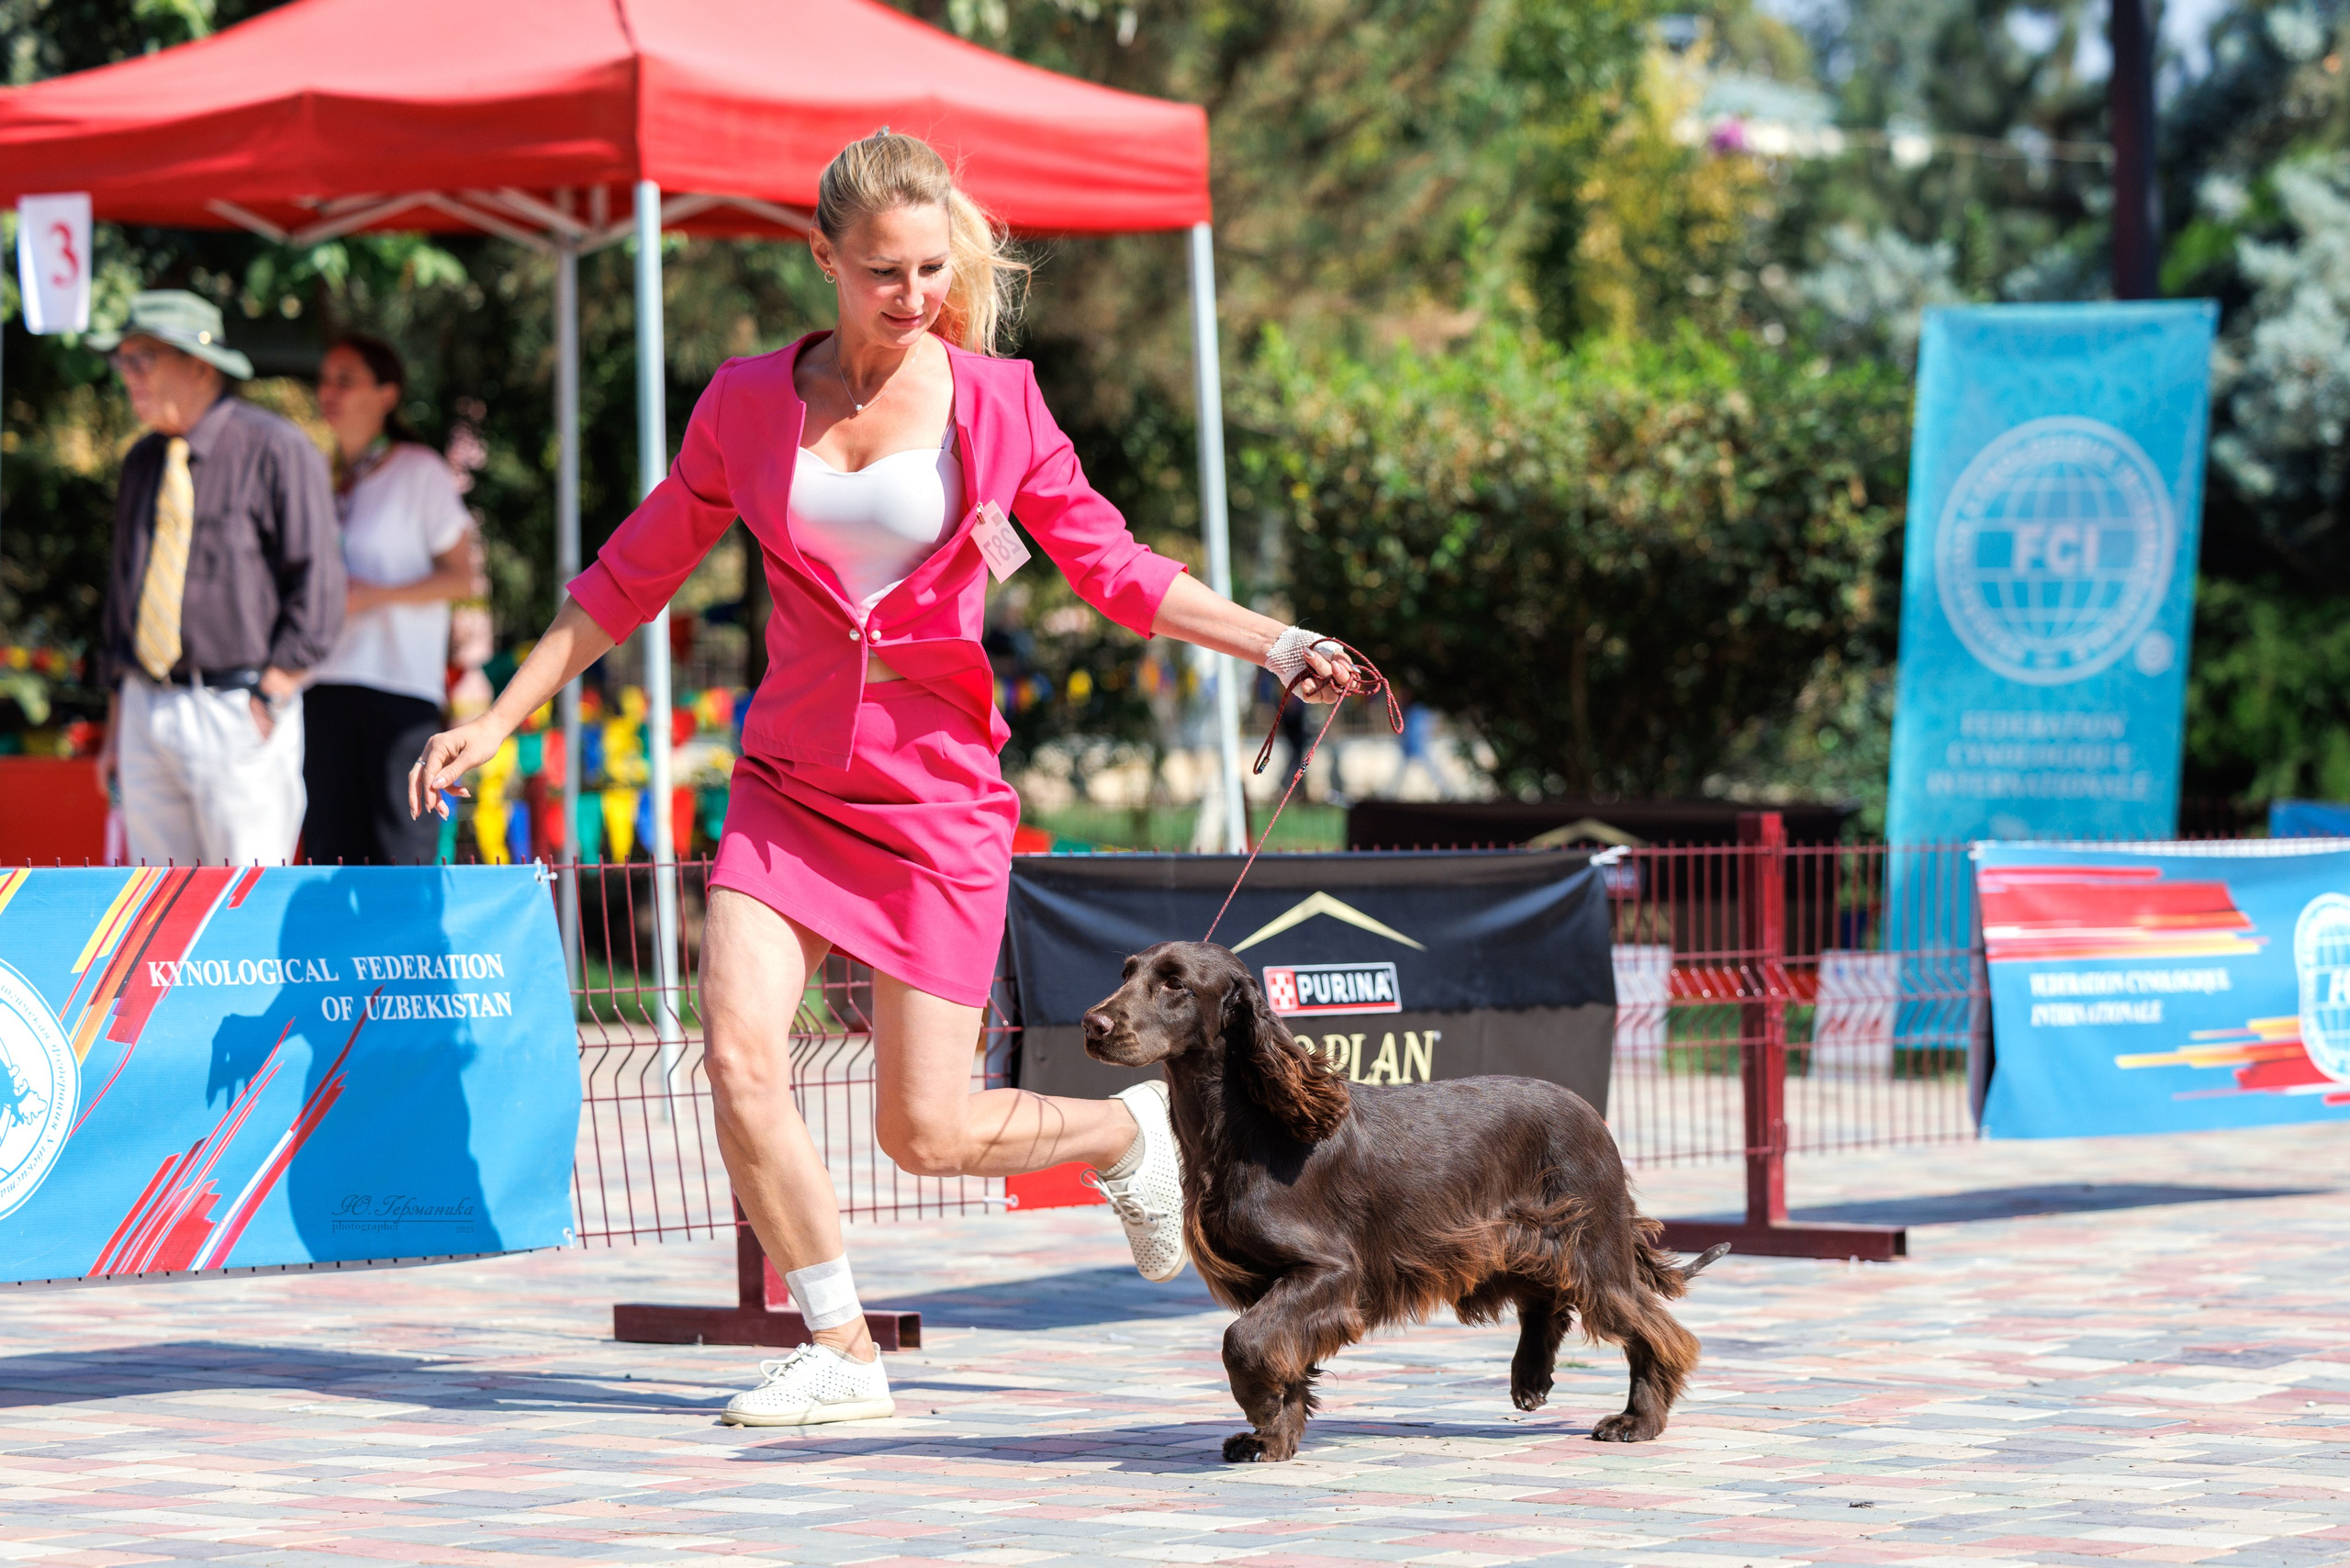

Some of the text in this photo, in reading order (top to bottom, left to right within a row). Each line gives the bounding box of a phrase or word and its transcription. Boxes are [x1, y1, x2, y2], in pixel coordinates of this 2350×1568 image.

[50, 221, 79, 289] 3
[2015, 522, 2099, 575] FCI
[147, 954, 505, 987] KYNOLOGICAL FEDERATION
[1296, 970, 1393, 1004] PURINA
[321, 991, 512, 1022] OF UZBEKISTAN
[1323, 1029, 1435, 1086] PLAN
